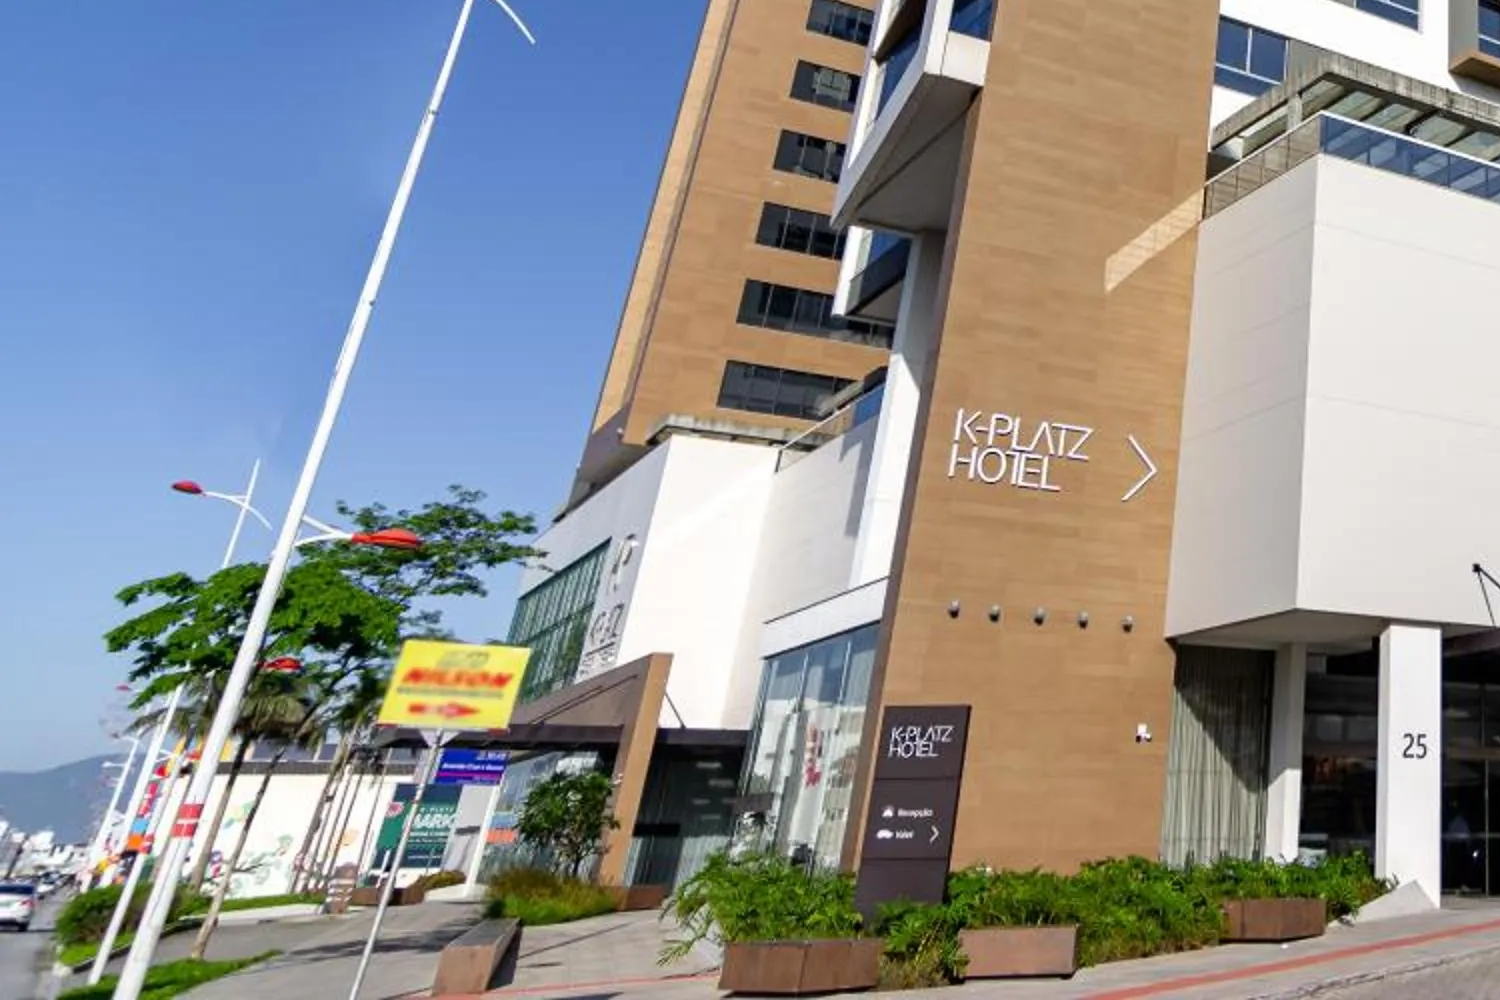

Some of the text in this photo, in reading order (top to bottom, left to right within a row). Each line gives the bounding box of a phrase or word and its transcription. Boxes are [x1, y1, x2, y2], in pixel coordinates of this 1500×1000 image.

[953, 407, 1094, 461] K-PLATZ
[948, 442, 1061, 492] HOTEL
[890, 725, 955, 743] K-PLATZ
[1402, 732, 1427, 760] 25
[888, 740, 939, 758] HOTEL
